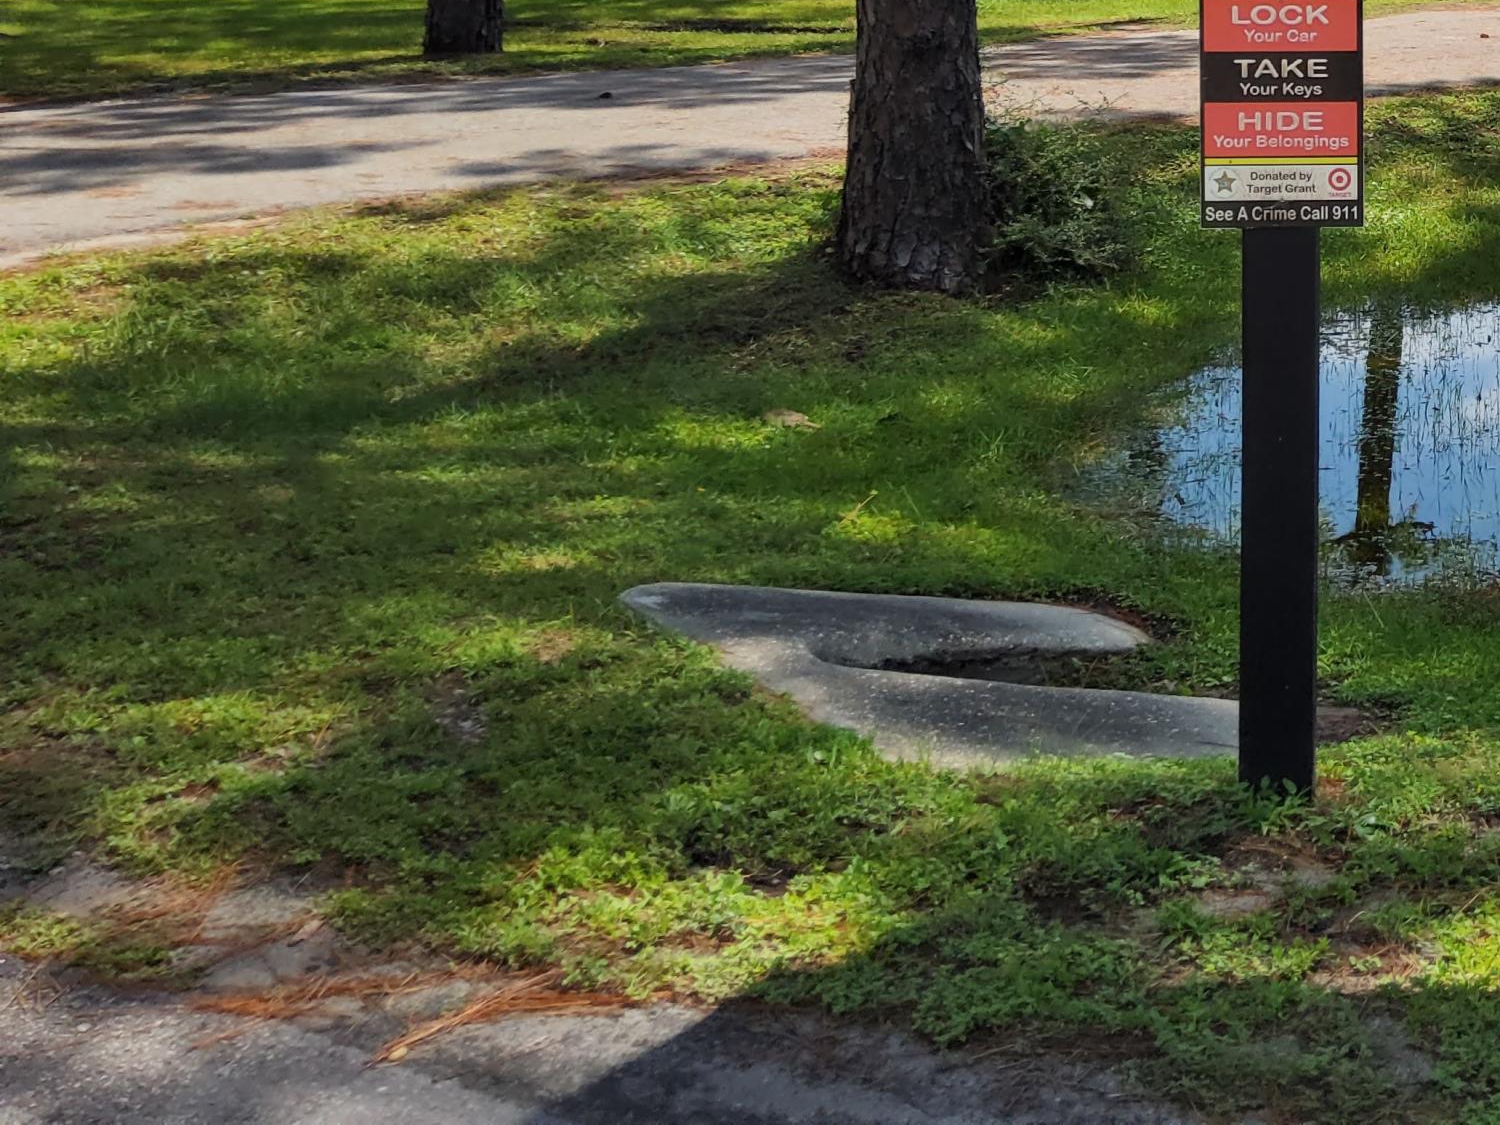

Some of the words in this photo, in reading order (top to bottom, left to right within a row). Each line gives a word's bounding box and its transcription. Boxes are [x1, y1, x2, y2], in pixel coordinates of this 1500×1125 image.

[1232, 5, 1329, 25] LOCK
[1244, 29, 1283, 42] Your
[1287, 29, 1317, 42] Car
[1233, 59, 1328, 78] TAKE
[1240, 83, 1278, 95] Your
[1283, 82, 1322, 98] Keys
[1238, 112, 1324, 131] HIDE
[1213, 135, 1252, 148] Your
[1256, 135, 1349, 150] Belongings
[1250, 171, 1296, 181] Donated
[1299, 171, 1312, 182] by
[1246, 184, 1282, 195] Target
[1285, 184, 1316, 193] Grant
[1205, 207, 1233, 221] See
[1237, 206, 1248, 221] A
[1252, 206, 1296, 221] Crime
[1300, 206, 1328, 220] Call
[1332, 205, 1357, 220] 911
